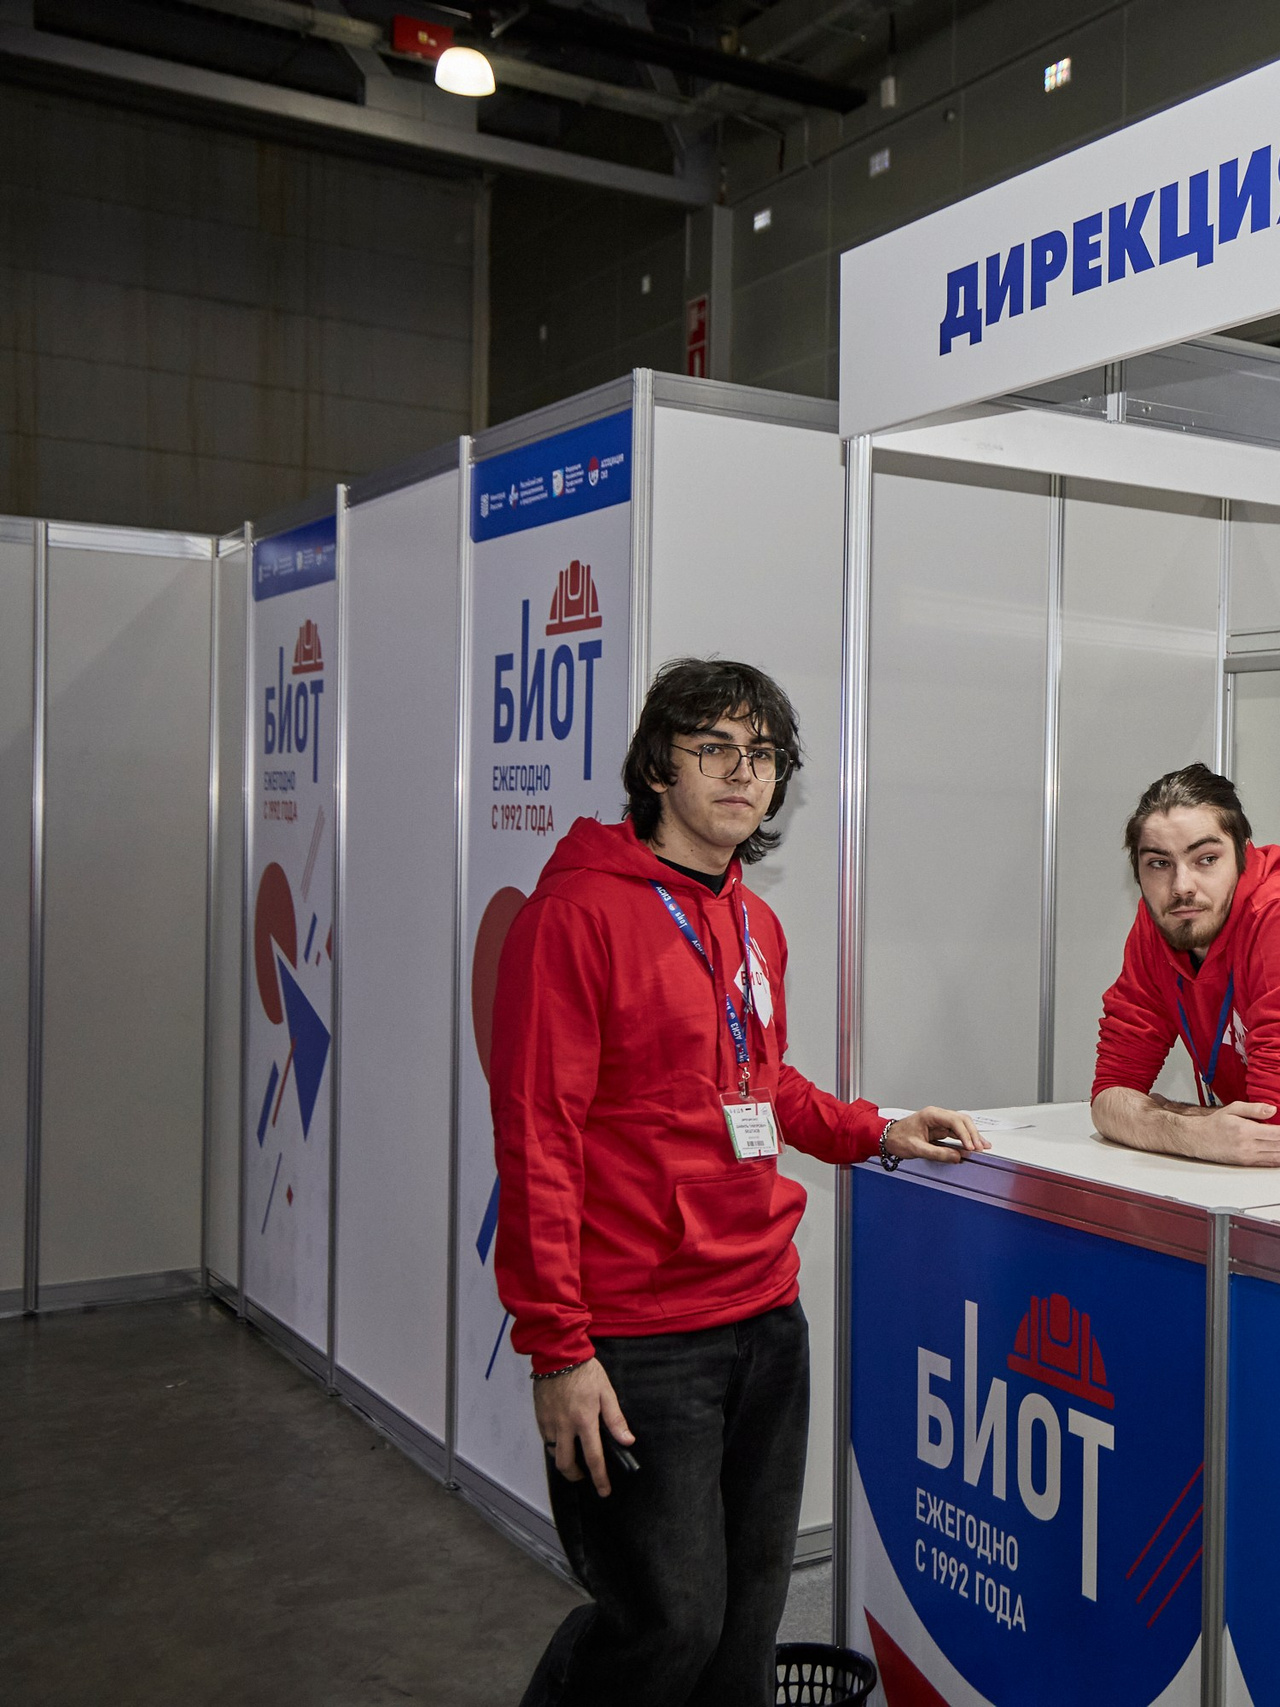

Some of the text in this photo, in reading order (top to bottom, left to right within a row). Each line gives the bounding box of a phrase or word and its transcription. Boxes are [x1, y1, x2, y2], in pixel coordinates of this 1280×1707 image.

[264, 646, 324, 784] БИОТ
[492, 599, 603, 781] БИОТ
[492, 764, 551, 796] ЕЖЕГОДНО
[501, 804, 522, 831] 1992
[525, 804, 554, 837] ГОДА
[916, 1299, 1115, 1603] БИОТ
[916, 1486, 1019, 1573] ЕЖЕГОДНО
[931, 1549, 969, 1600] 1992
[975, 1572, 1027, 1633] ГОДА
